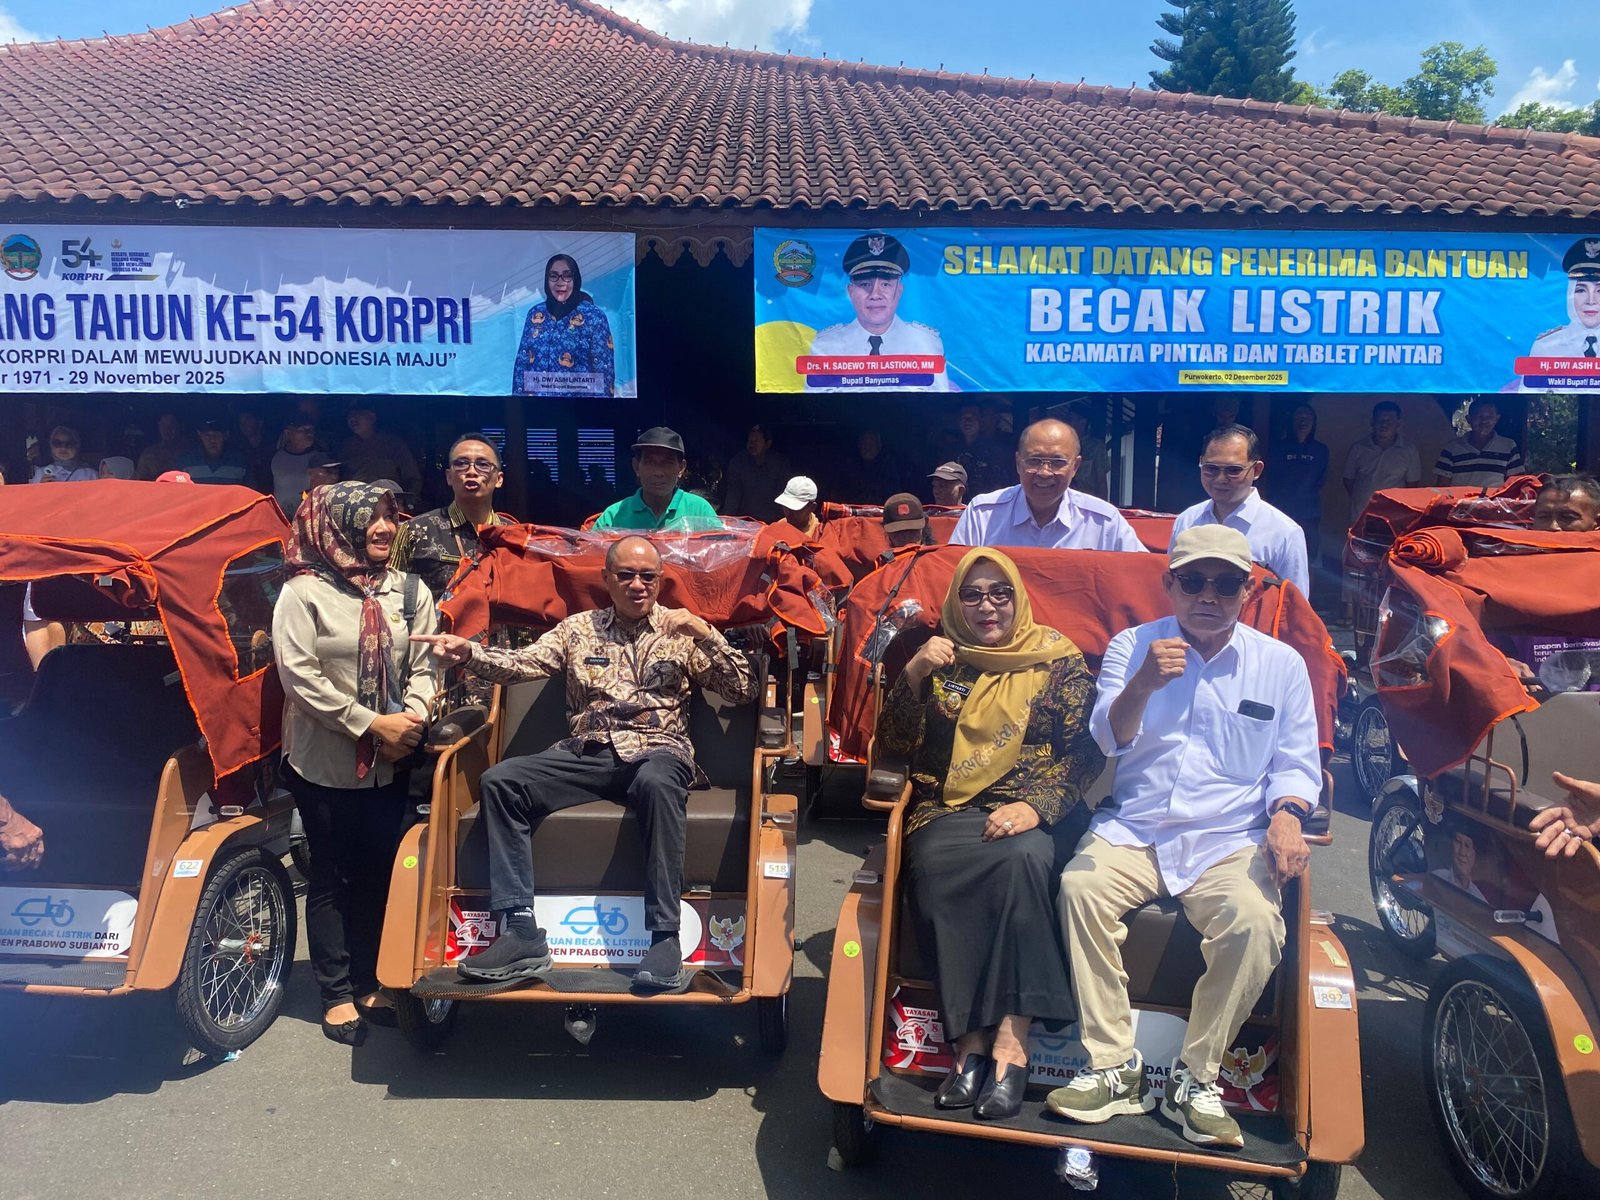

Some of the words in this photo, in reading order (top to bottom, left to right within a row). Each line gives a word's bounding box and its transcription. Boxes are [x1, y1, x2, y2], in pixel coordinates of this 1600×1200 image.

[61, 236, 103, 268] 54
[943, 245, 1085, 275] SELAMAT
[1091, 246, 1214, 276] DATANG
[1220, 247, 1378, 277] PENERIMA
[1384, 249, 1529, 279] BANTUAN
[61, 272, 104, 281] KORPRI
[1029, 288, 1206, 333] BECAK
[1231, 289, 1441, 335] LISTRIK
[0, 293, 56, 341] NG
[66, 293, 194, 341] TAHUN
[206, 294, 324, 343] KE-54
[334, 295, 473, 345] KORPRI
[71, 350, 138, 364] DALAM
[144, 350, 282, 365] MEWUJUDKAN
[288, 351, 392, 367] INDONESIA
[1025, 343, 1145, 363] KACAMATA
[1150, 344, 1228, 364] PINTAR
[1232, 344, 1278, 364] DAN
[1283, 344, 1360, 365] TABLET
[1363, 345, 1443, 366] PINTAR
[806, 361, 822, 371] Drs.
[823, 361, 832, 370] H.
[832, 361, 865, 370] SADEWO
[865, 361, 879, 370] TRI
[880, 360, 920, 371] LASTIONO,
[920, 360, 935, 369] MM
[1540, 361, 1552, 372] Hj.
[1554, 361, 1570, 370] DWI
[1571, 361, 1593, 370] ASIH
[16, 370, 51, 385] 1971
[69, 370, 89, 385] 29
[94, 370, 180, 385] November
[185, 370, 225, 385] 2025
[841, 376, 864, 386] Bupati
[864, 376, 900, 386] Banyumas
[1184, 374, 1224, 382] Purwokerto,
[1547, 378, 1566, 386] Wakil
[1566, 378, 1588, 388] Bupati
[180, 861, 200, 870] 622
[768, 864, 787, 873] 518
[21, 928, 55, 938] BECAK
[56, 930, 92, 940] LISTRIK
[94, 931, 119, 940] DARI
[15, 939, 67, 949] PRABOWO
[68, 941, 120, 951] SUBIANTO
[574, 937, 610, 947] BECAK
[612, 938, 651, 947] LISTRIK
[569, 948, 625, 957] PRABOWO
[1321, 993, 1343, 1003] 892
[905, 1008, 936, 1018] YAYASAN
